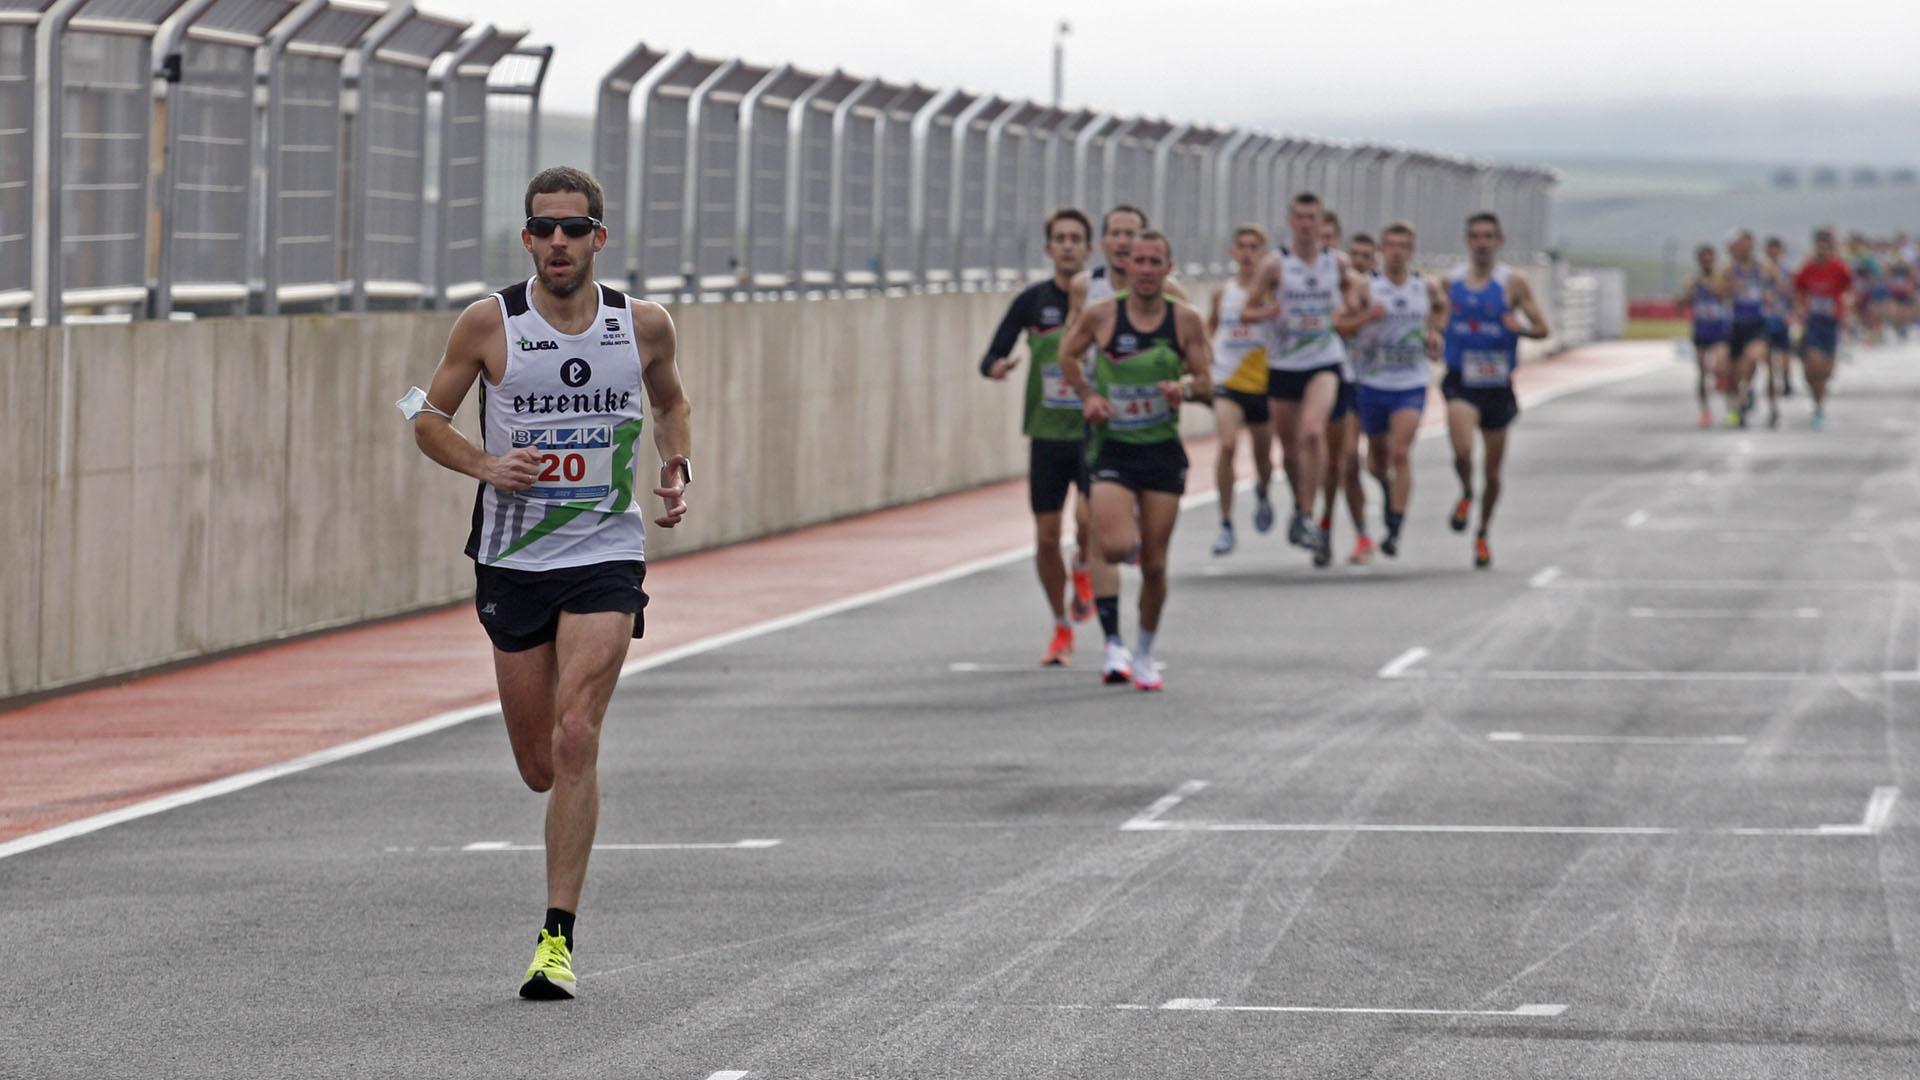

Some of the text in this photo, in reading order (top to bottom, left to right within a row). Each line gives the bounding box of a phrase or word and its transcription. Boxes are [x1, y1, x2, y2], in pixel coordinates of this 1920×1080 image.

[521, 340, 559, 351] LUGA
[513, 387, 630, 414] etxenike
[511, 424, 609, 445] BALAKI
[538, 453, 586, 482] 20
